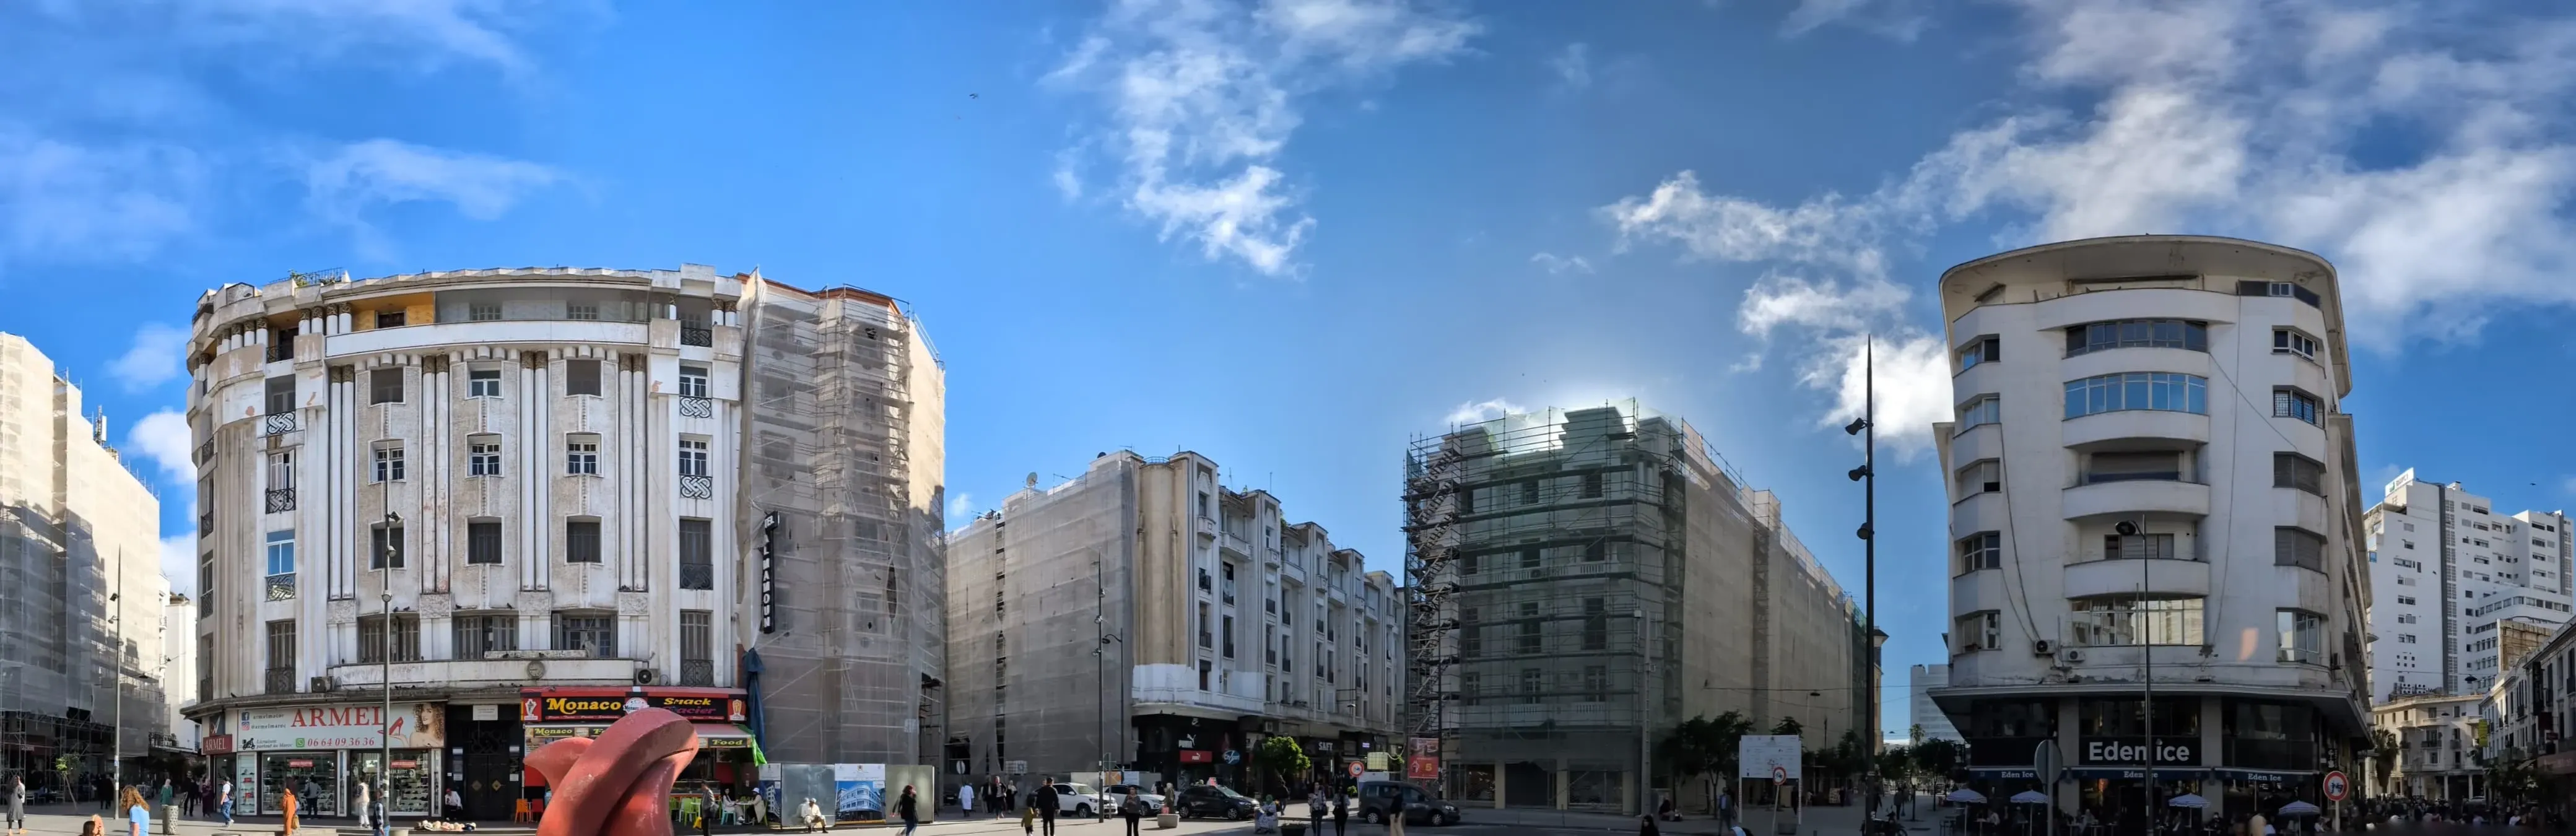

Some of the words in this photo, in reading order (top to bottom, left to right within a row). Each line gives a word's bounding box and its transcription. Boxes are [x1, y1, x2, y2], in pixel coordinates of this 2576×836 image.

[546, 698, 621, 715] Monaco
[291, 707, 383, 727] ARMEL
[534, 728, 572, 736] Monaco
[205, 738, 227, 751] ARMEL
[307, 738, 318, 747] 06
[321, 738, 333, 747] 64
[335, 738, 346, 747] 09
[349, 738, 360, 746] 36
[362, 737, 375, 746] 36
[2089, 741, 2147, 760] Eden
[2156, 738, 2190, 761] ice
